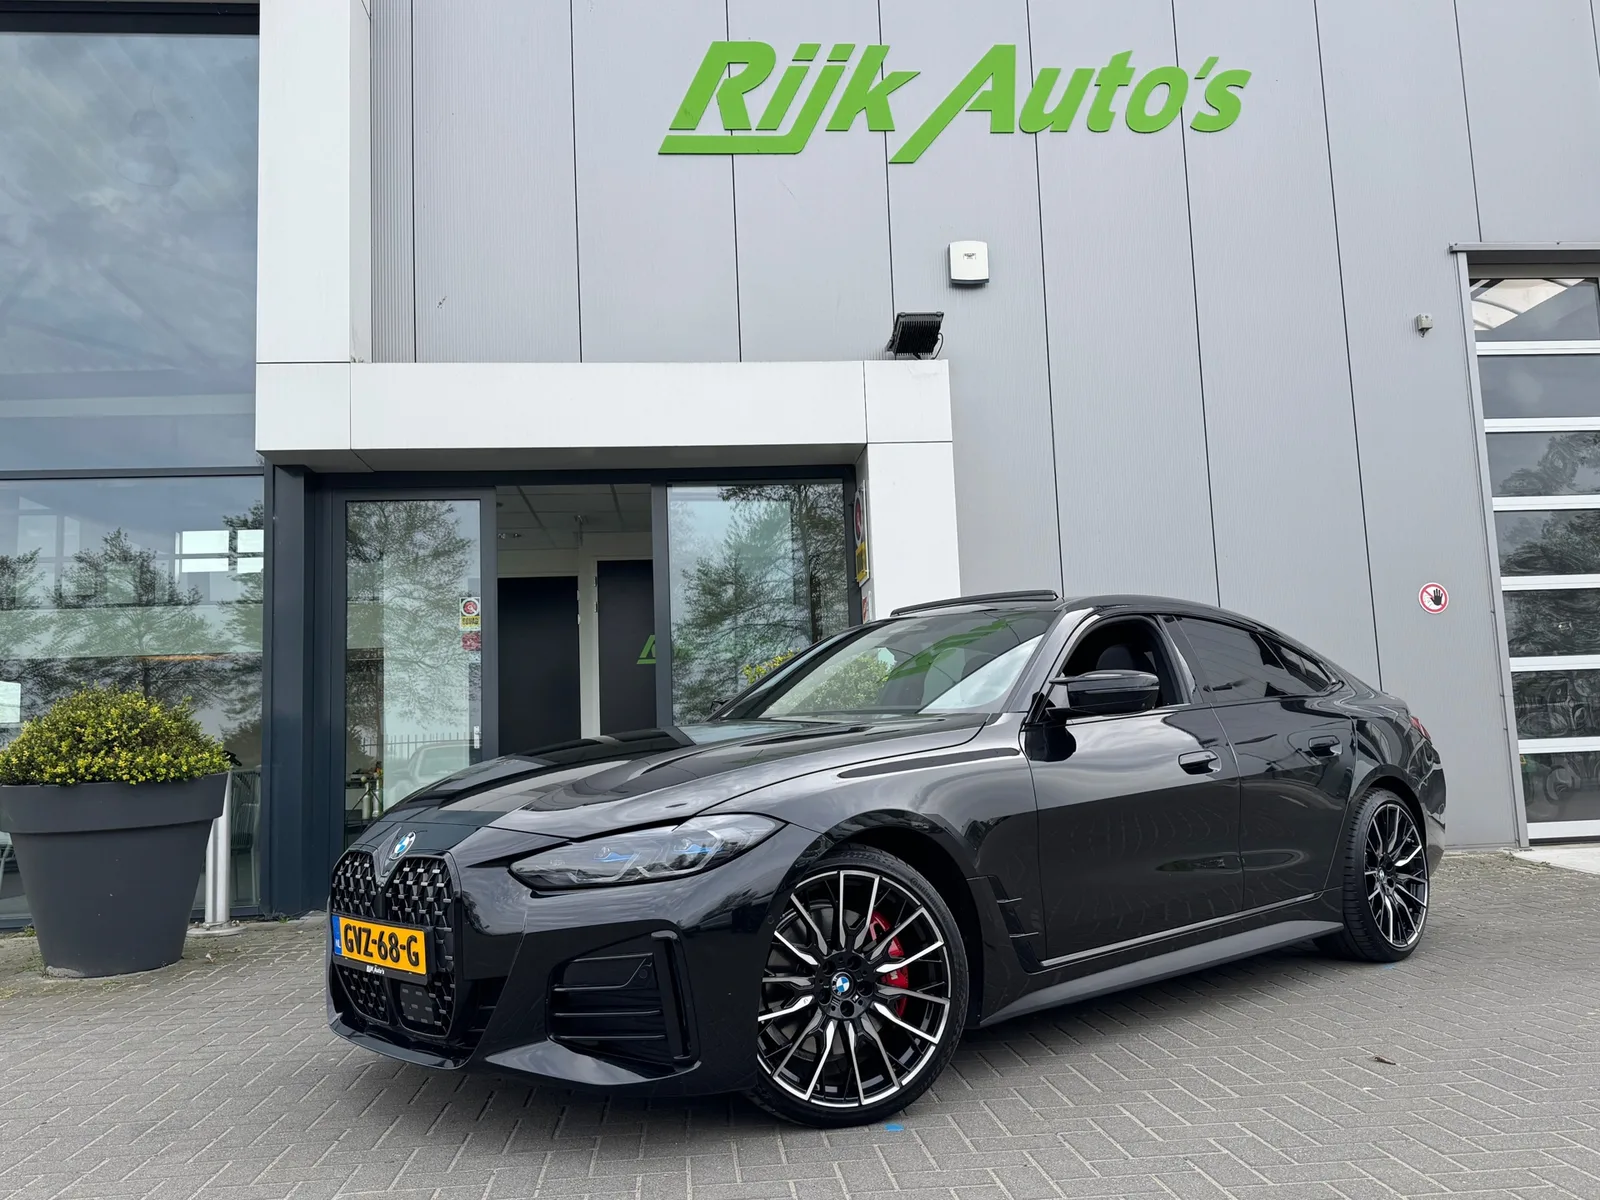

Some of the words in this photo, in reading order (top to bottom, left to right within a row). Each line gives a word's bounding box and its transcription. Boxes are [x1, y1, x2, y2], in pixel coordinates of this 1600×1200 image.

[658, 40, 921, 155] Rijk
[888, 43, 1252, 164] Auto's
[343, 923, 420, 967] GVZ-68-G
